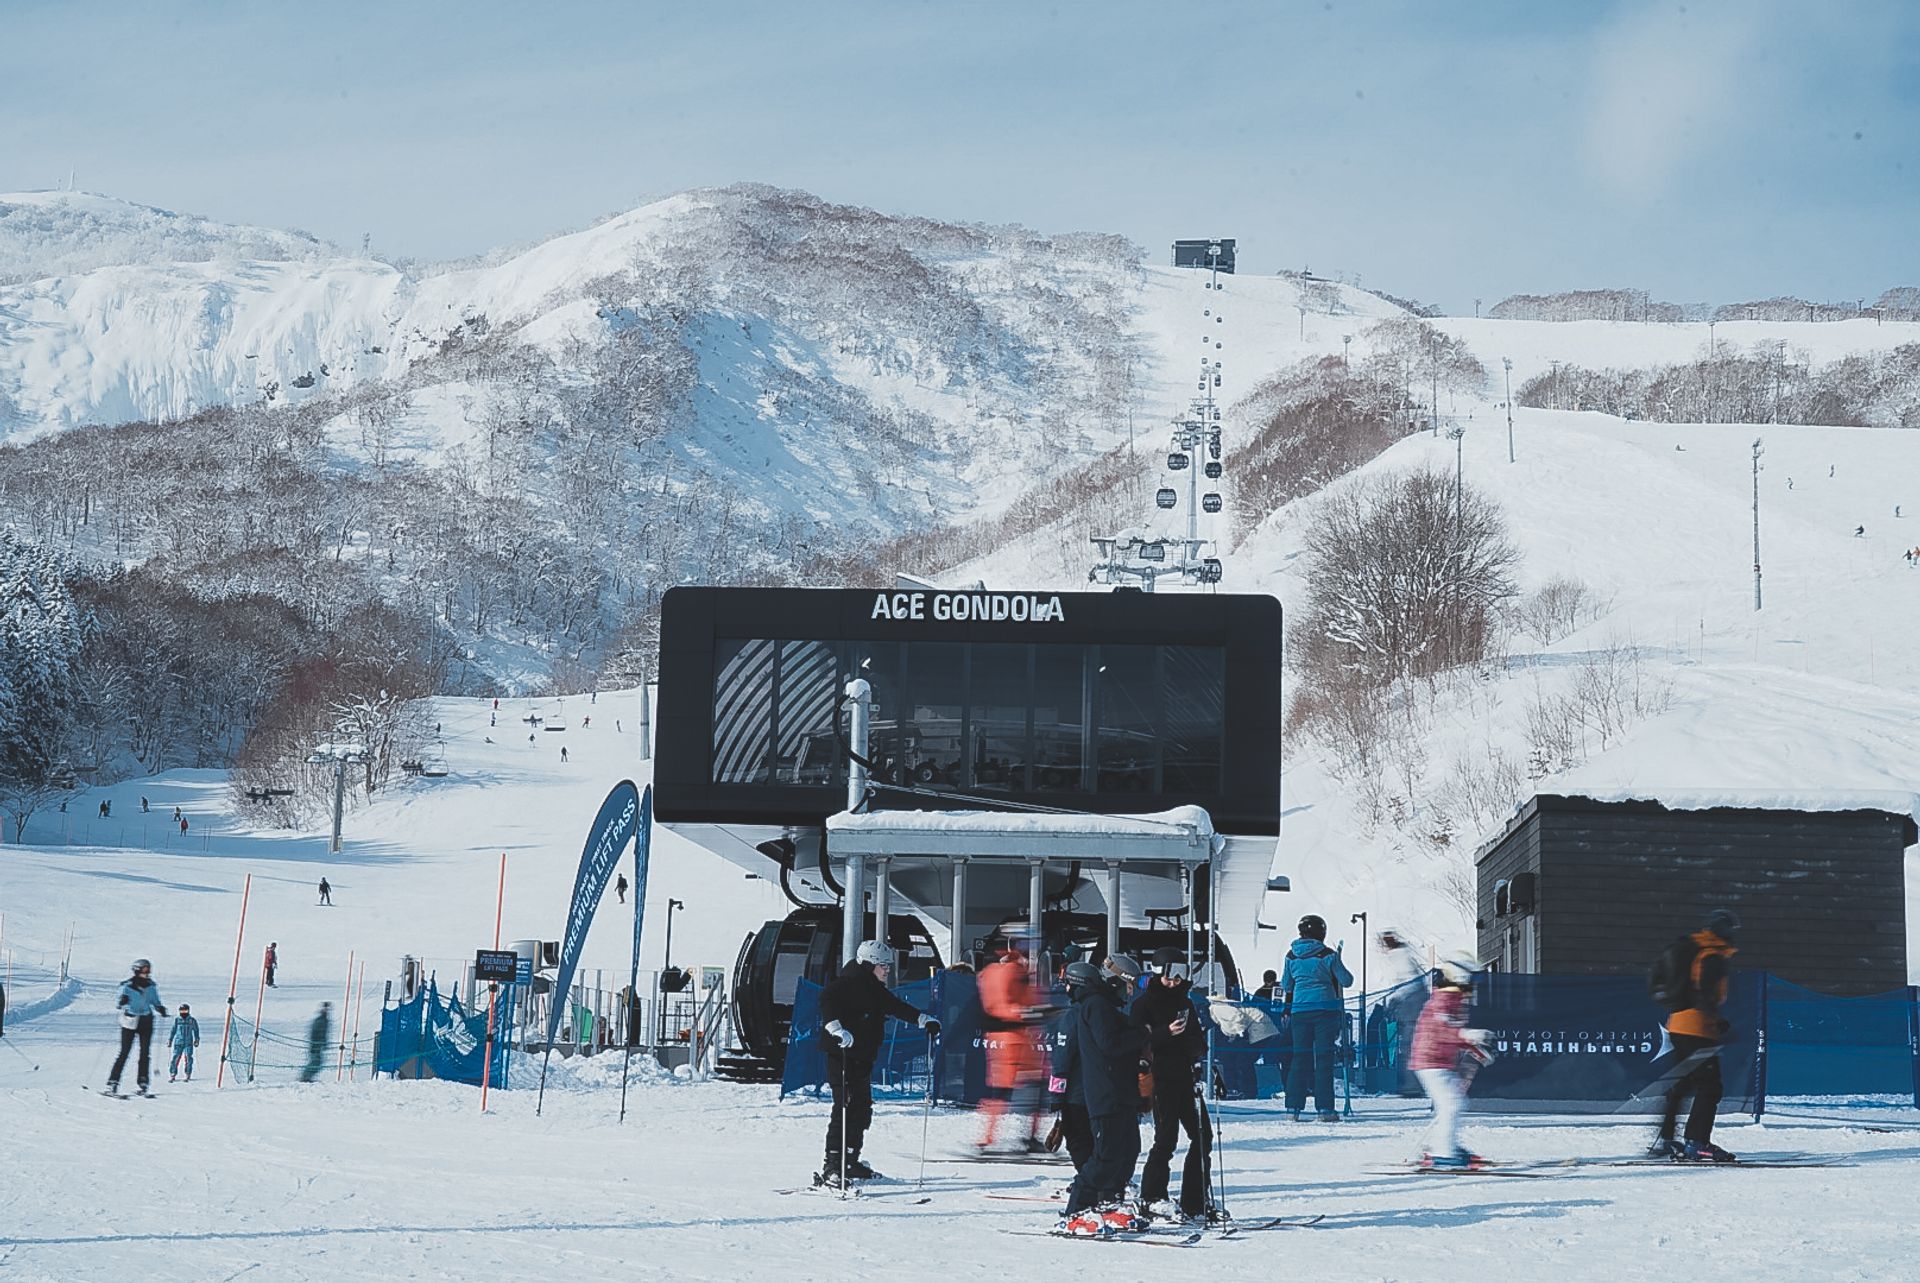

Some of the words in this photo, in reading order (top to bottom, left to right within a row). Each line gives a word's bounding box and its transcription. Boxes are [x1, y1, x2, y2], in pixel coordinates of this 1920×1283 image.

[871, 593, 925, 620] ACE
[933, 594, 1065, 622] GONDOLA
[564, 873, 597, 965] PREMIUM
[596, 837, 613, 875] LIFT
[612, 798, 635, 841] PASS
[480, 957, 513, 966] PREMIUM
